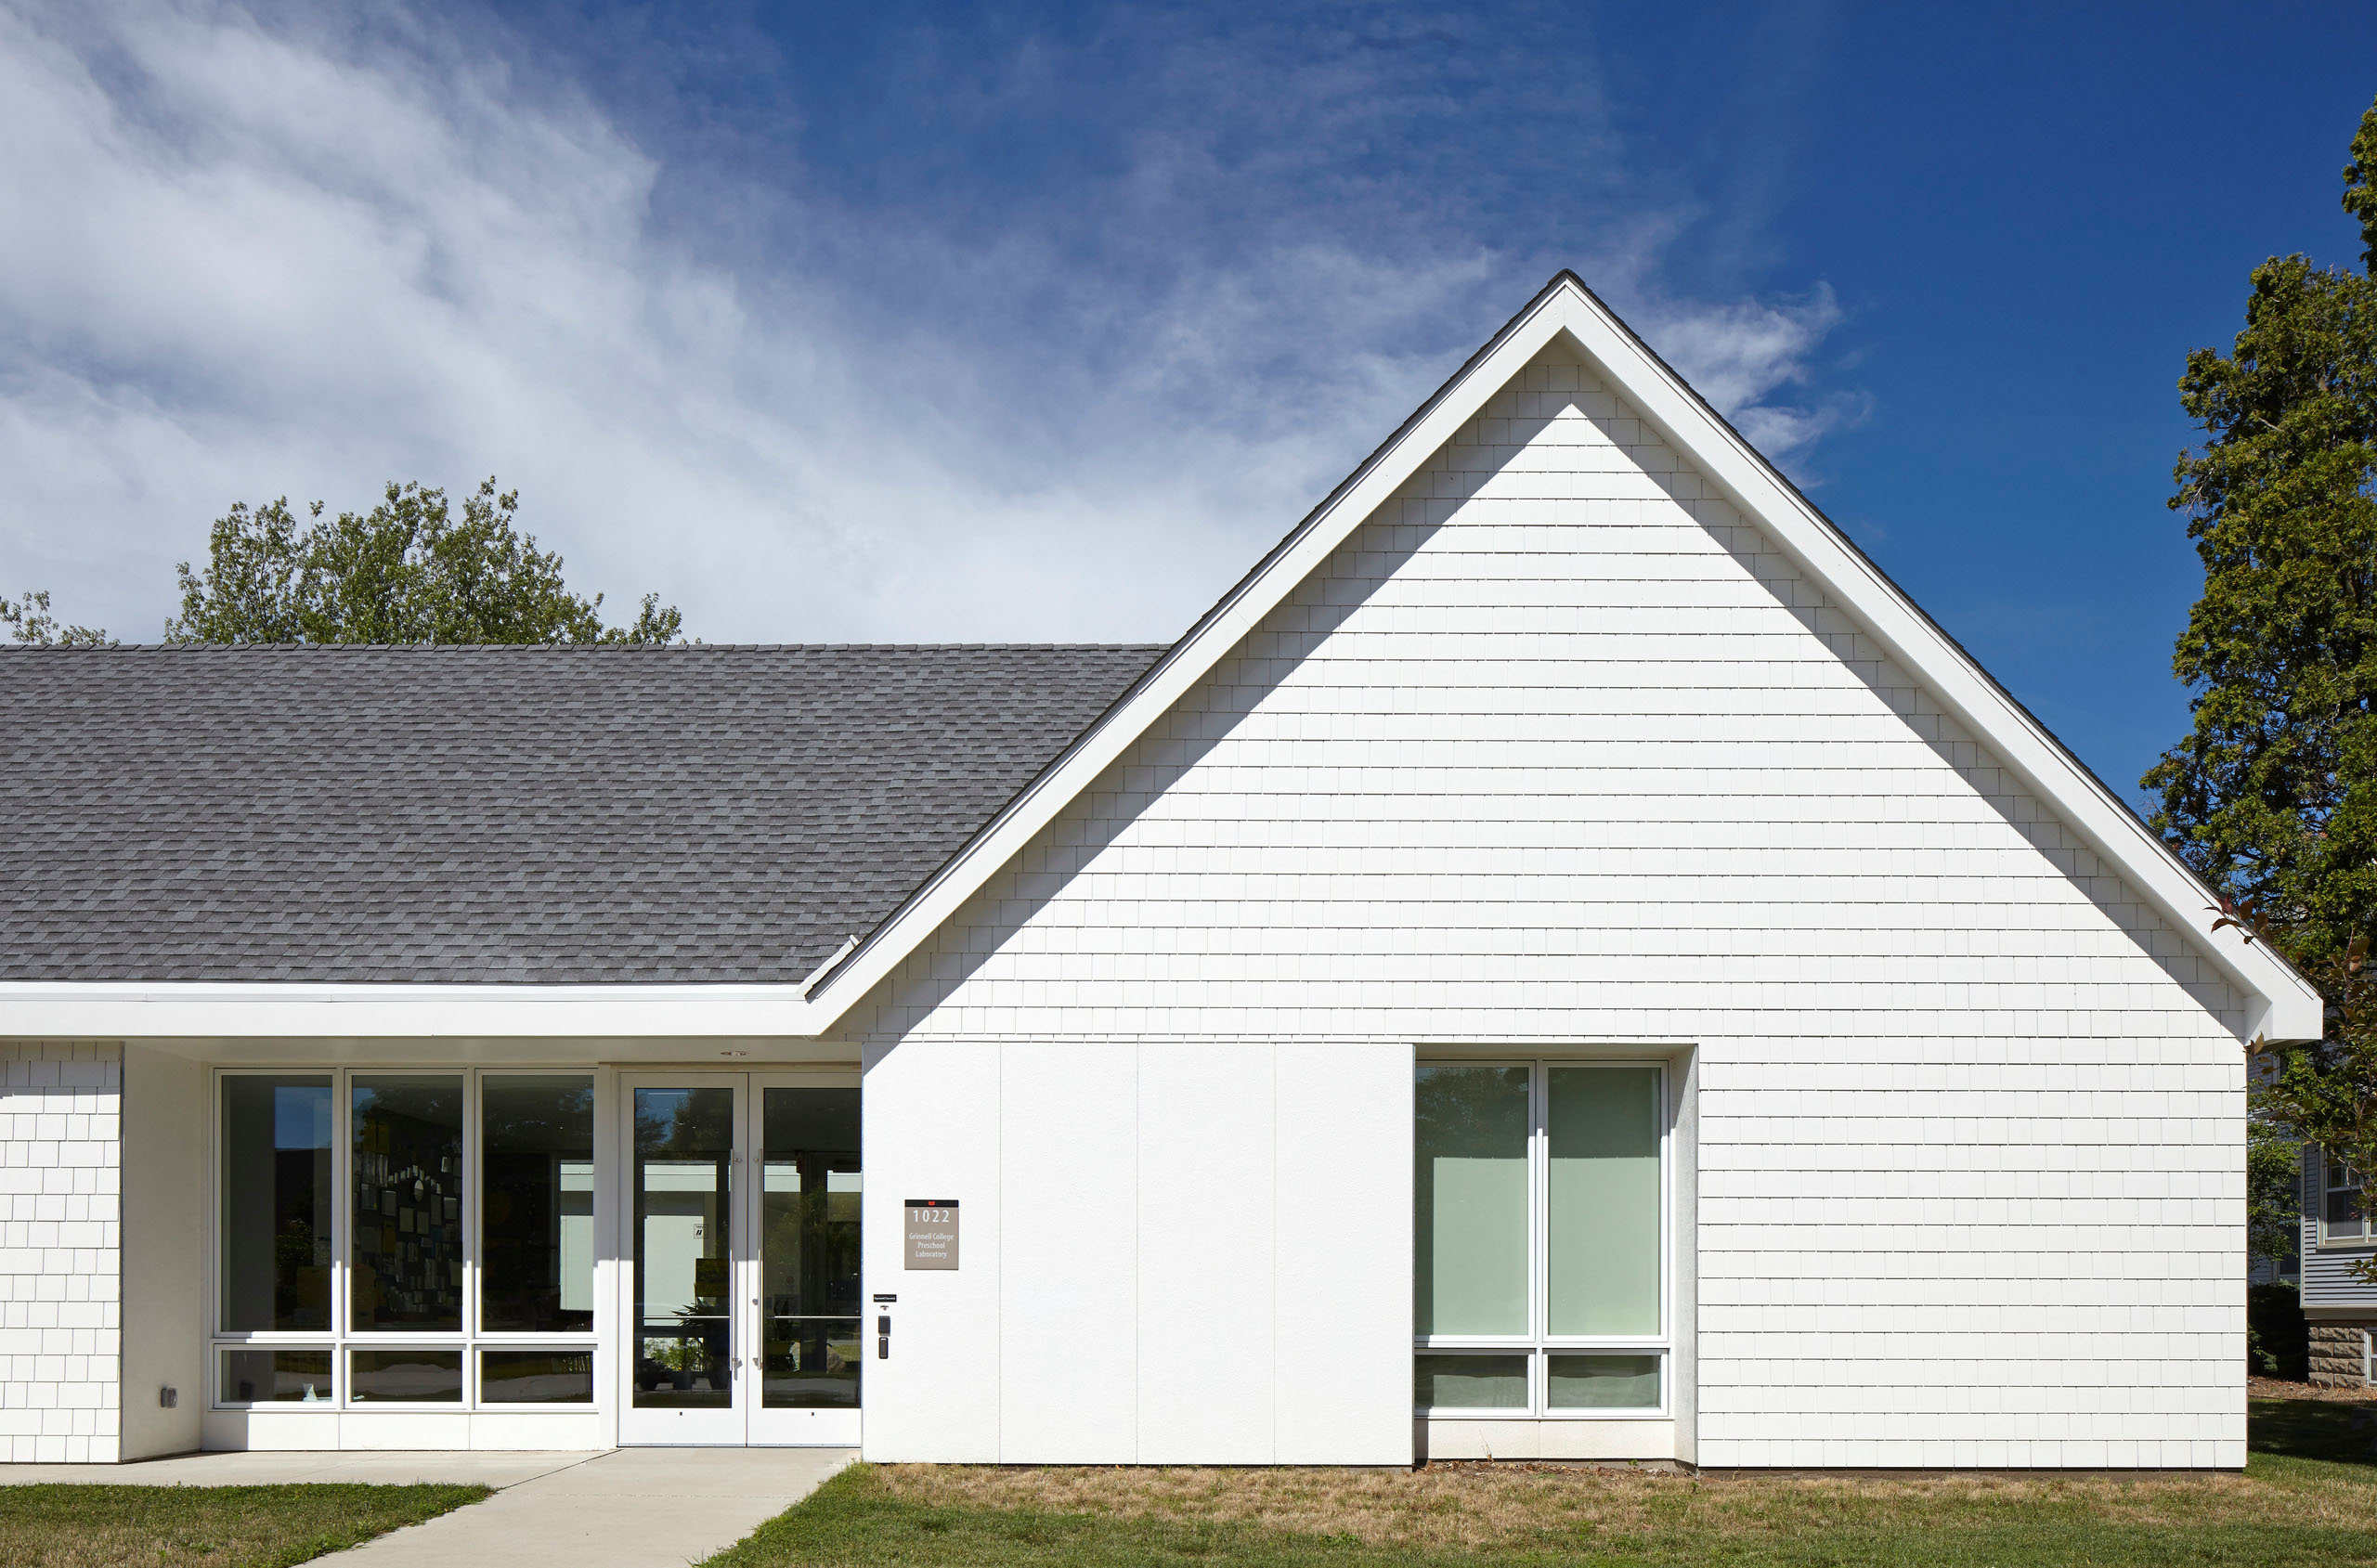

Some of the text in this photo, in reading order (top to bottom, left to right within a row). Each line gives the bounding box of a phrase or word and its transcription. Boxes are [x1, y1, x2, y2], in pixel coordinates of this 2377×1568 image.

[913, 1210, 950, 1223] 1022
[909, 1232, 955, 1241] Grinnell College
[916, 1251, 947, 1259] Laboratory
